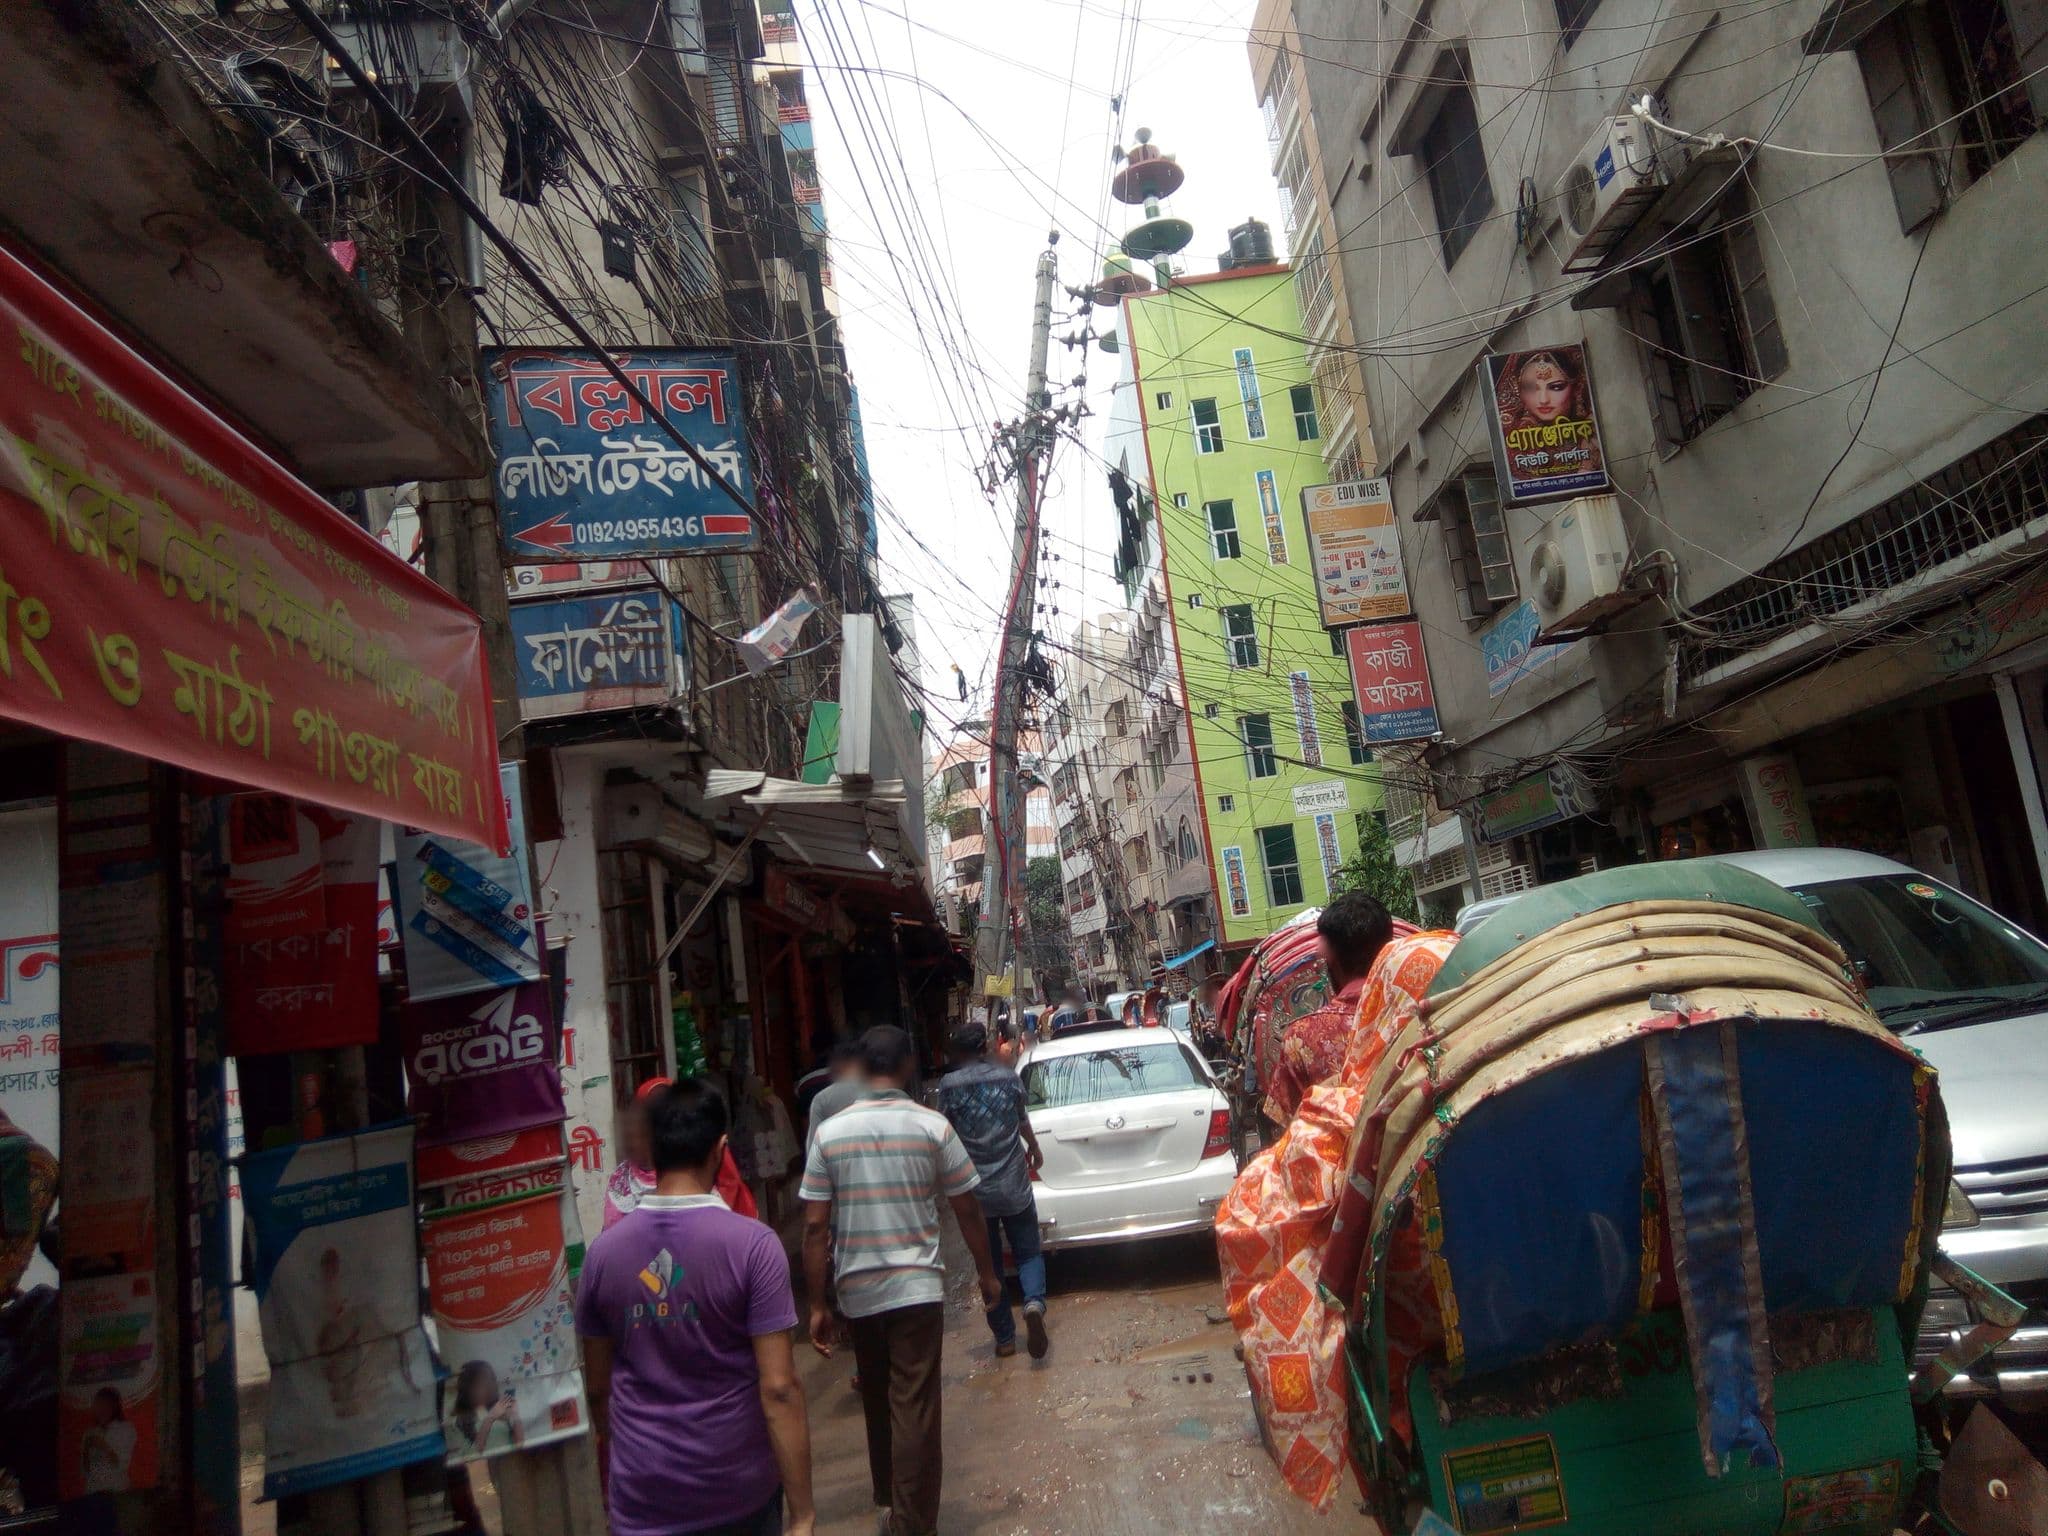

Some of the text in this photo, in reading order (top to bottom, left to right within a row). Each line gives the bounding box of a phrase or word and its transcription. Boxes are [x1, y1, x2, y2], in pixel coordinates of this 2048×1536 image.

[501, 437, 594, 499] লেডিস
[1516, 447, 1590, 468] বিউটি পার্লার
[1337, 482, 1381, 500] EDU WISE
[576, 515, 700, 543] 01924955436
[1364, 640, 1413, 672] কাজী
[1364, 676, 1424, 709] অফিস
[87, 623, 143, 708] ও
[162, 643, 274, 762] মাঠা
[293, 705, 401, 796] পাওয়া
[409, 751, 464, 818] যায়
[422, 1023, 482, 1046] ROCKET
